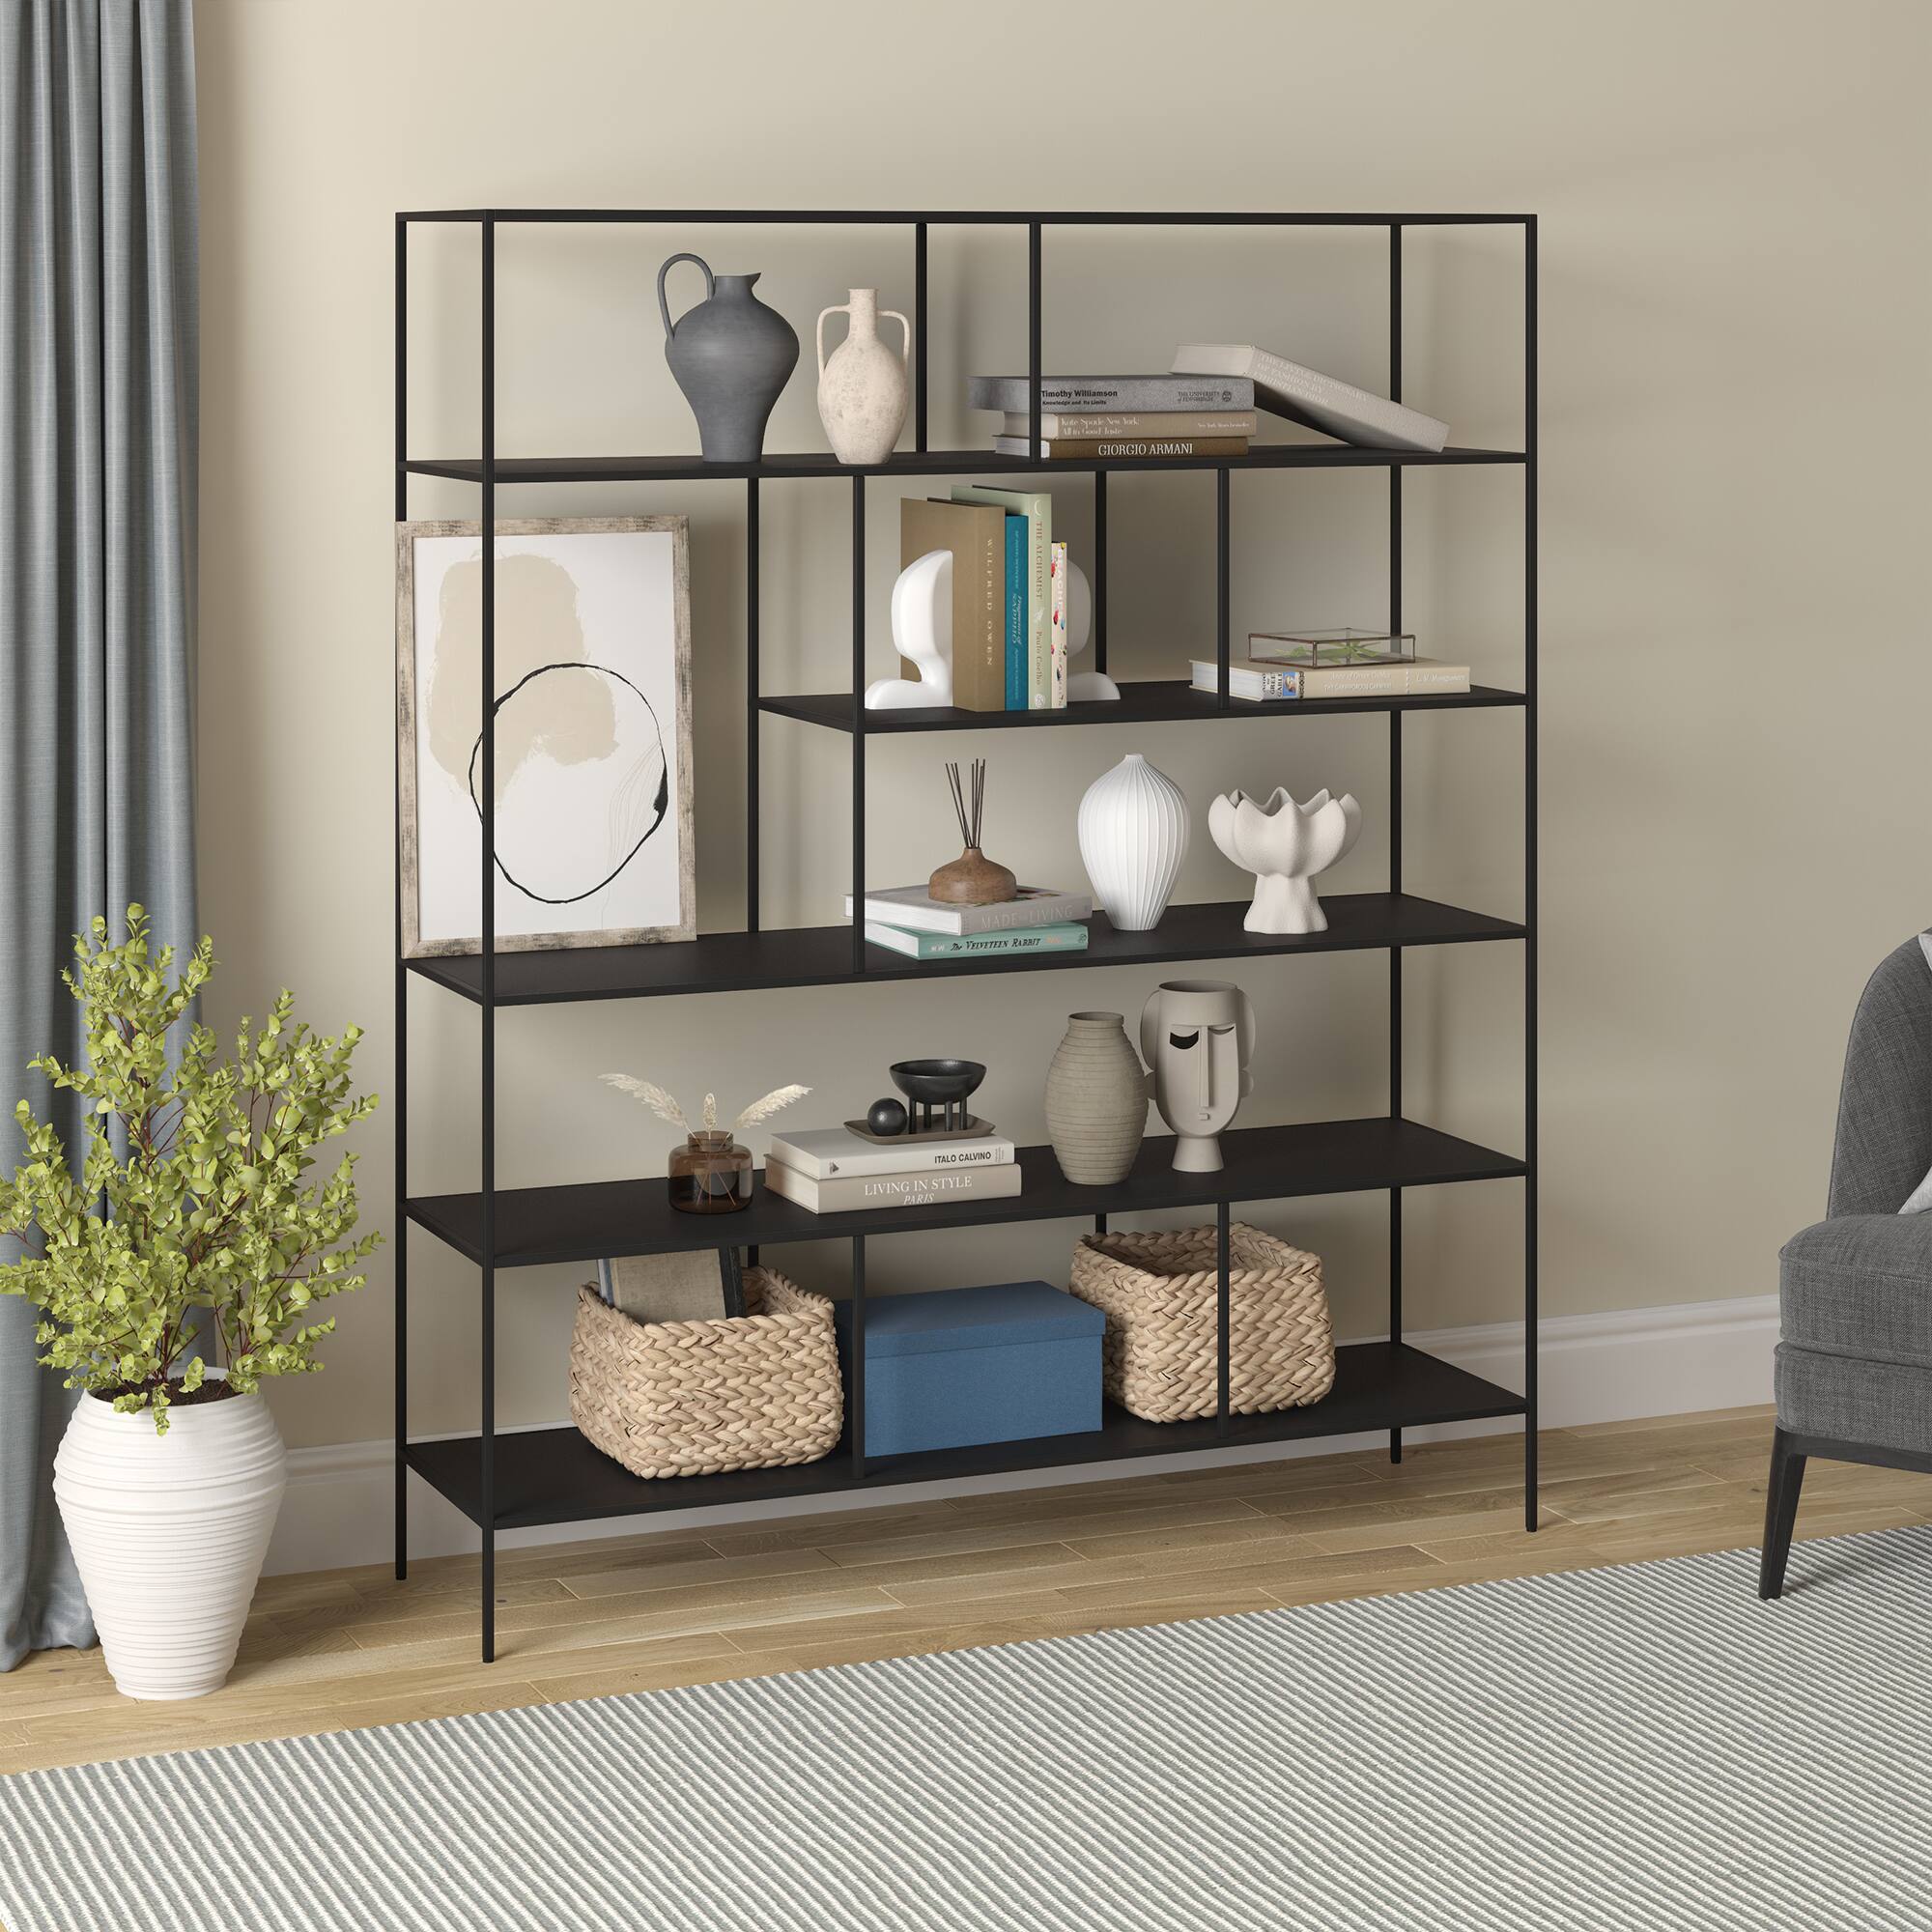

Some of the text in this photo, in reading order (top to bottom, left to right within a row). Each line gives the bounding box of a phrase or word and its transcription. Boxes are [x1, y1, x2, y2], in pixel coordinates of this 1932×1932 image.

[1041, 389, 1072, 398] Timothy
[1097, 442, 1193, 456] GIORGIO ARMANI
[980, 904, 1074, 929] MADE LIVING
[951, 942, 962, 952] The
[966, 940, 1009, 951] VELVETEEN
[1012, 937, 1041, 948] RABBIT
[934, 1153, 956, 1164] ITALO
[958, 1151, 992, 1162] CALVINO
[865, 1176, 973, 1196] LIVING IN STYLE
[903, 1193, 935, 1206] PARIS
